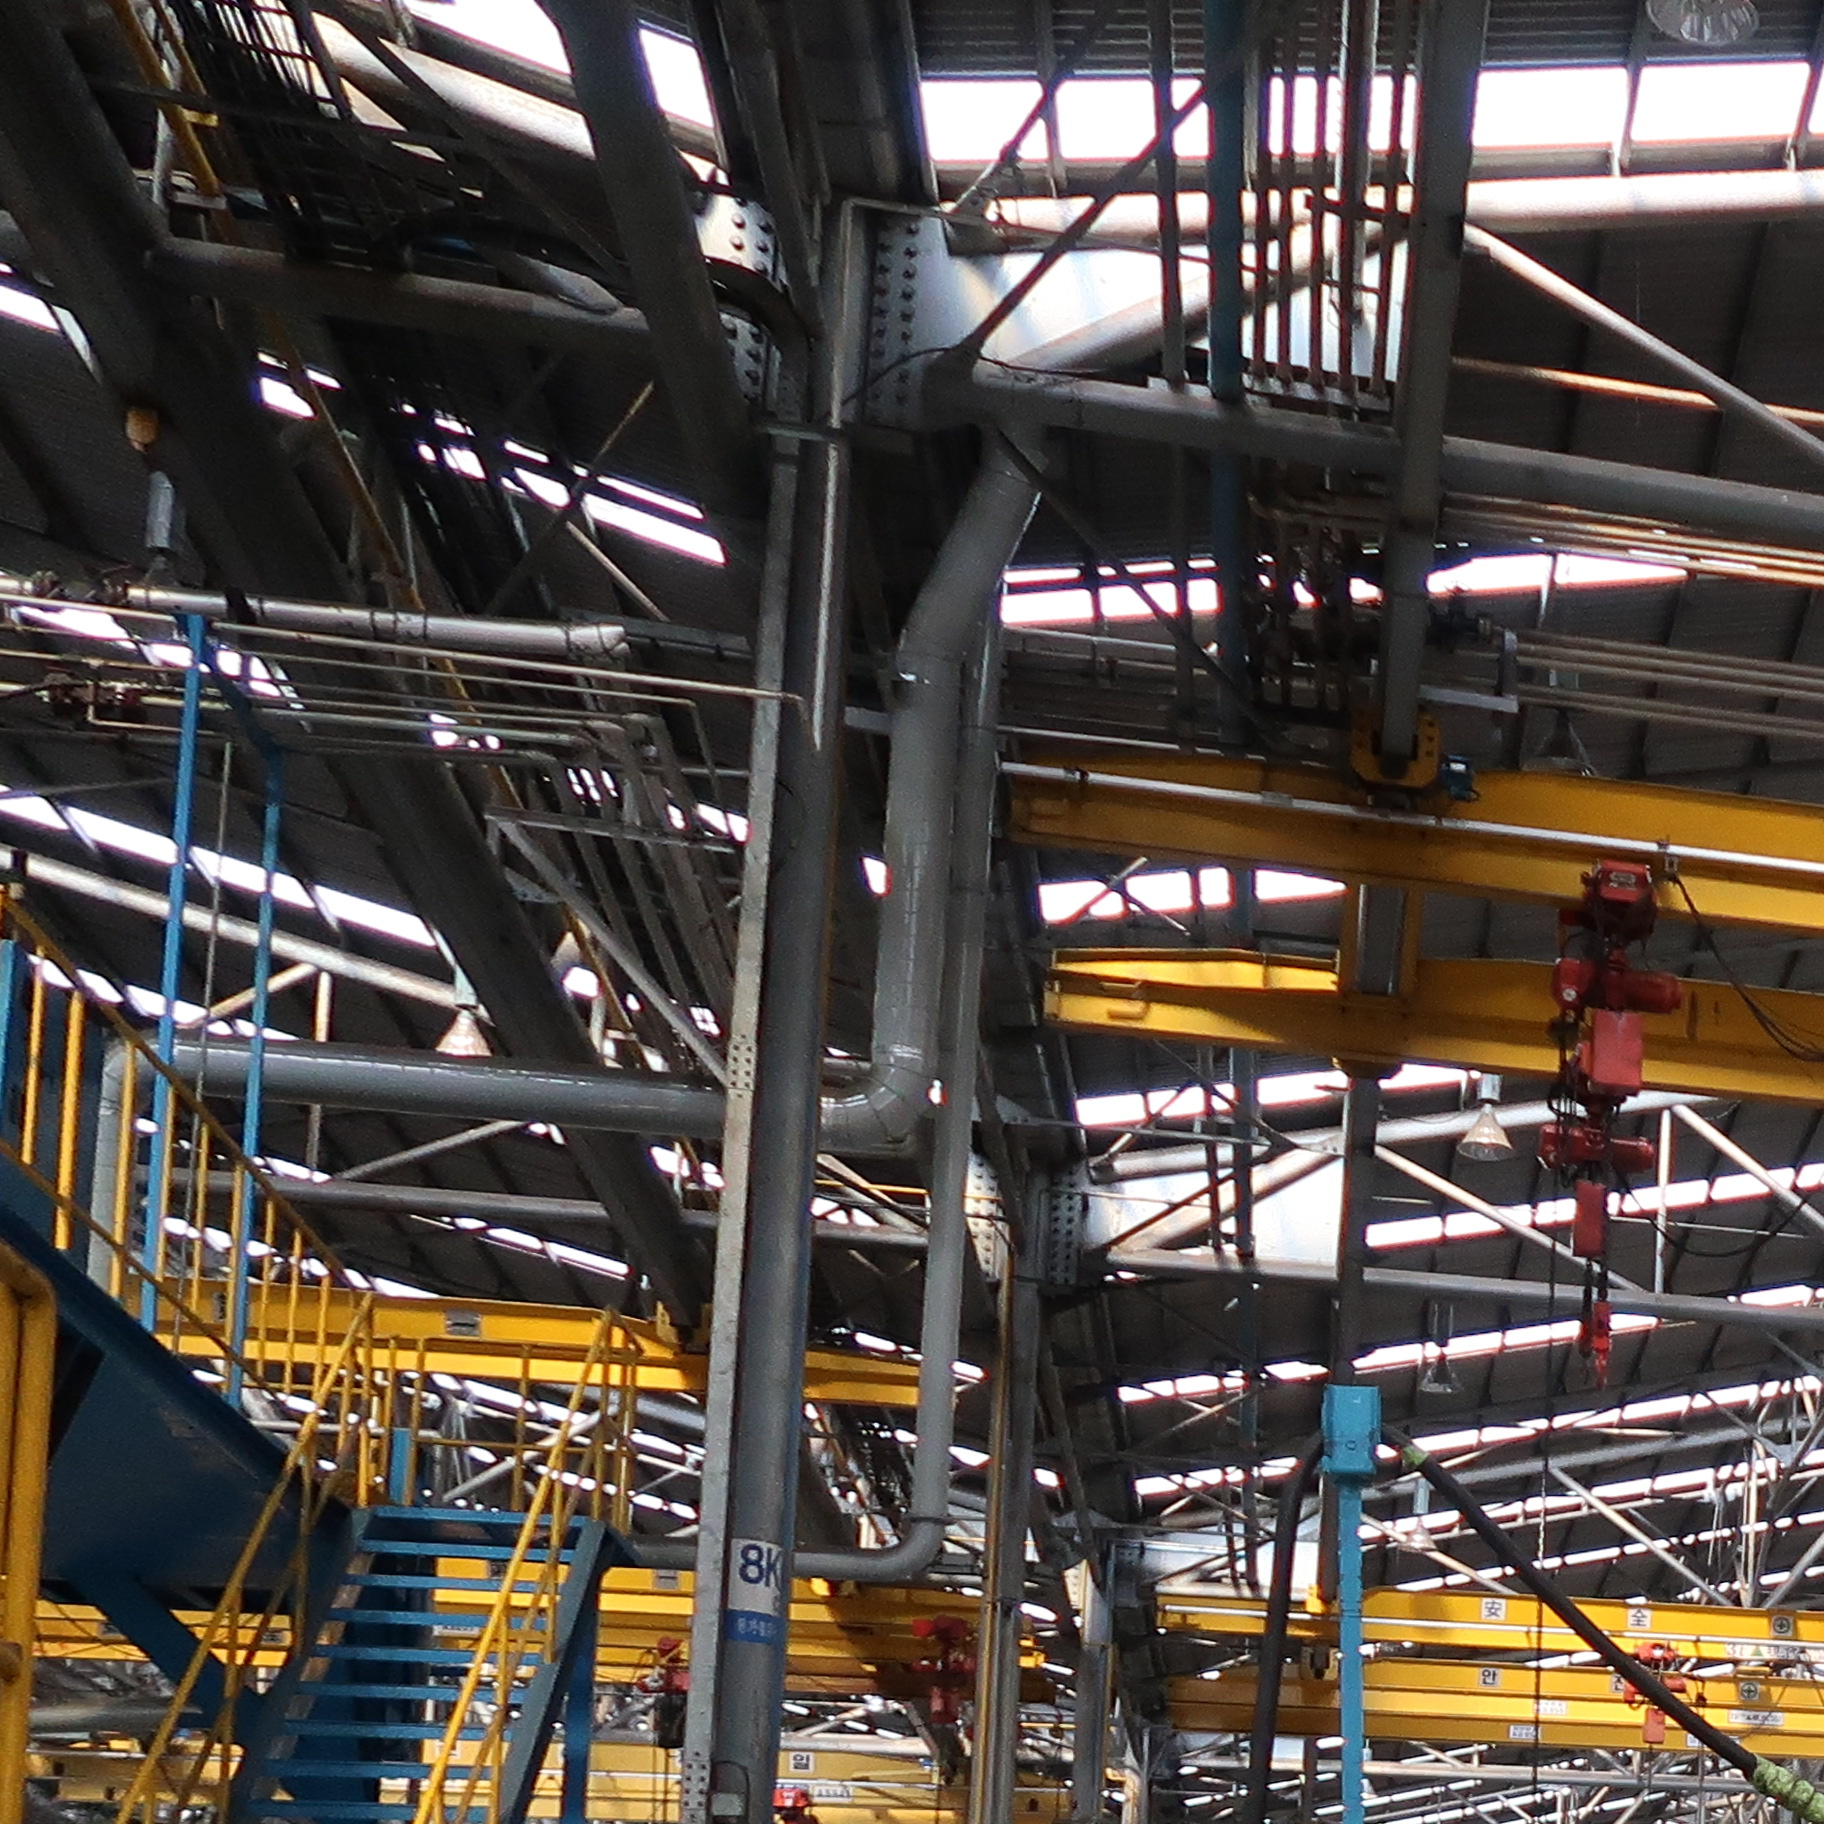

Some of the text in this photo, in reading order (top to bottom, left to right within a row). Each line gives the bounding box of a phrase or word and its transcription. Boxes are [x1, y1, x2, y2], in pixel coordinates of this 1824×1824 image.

[1484, 1600, 1502, 1618] 安
[1630, 1608, 1647, 1627] 全
[1482, 1668, 1497, 1685] 안
